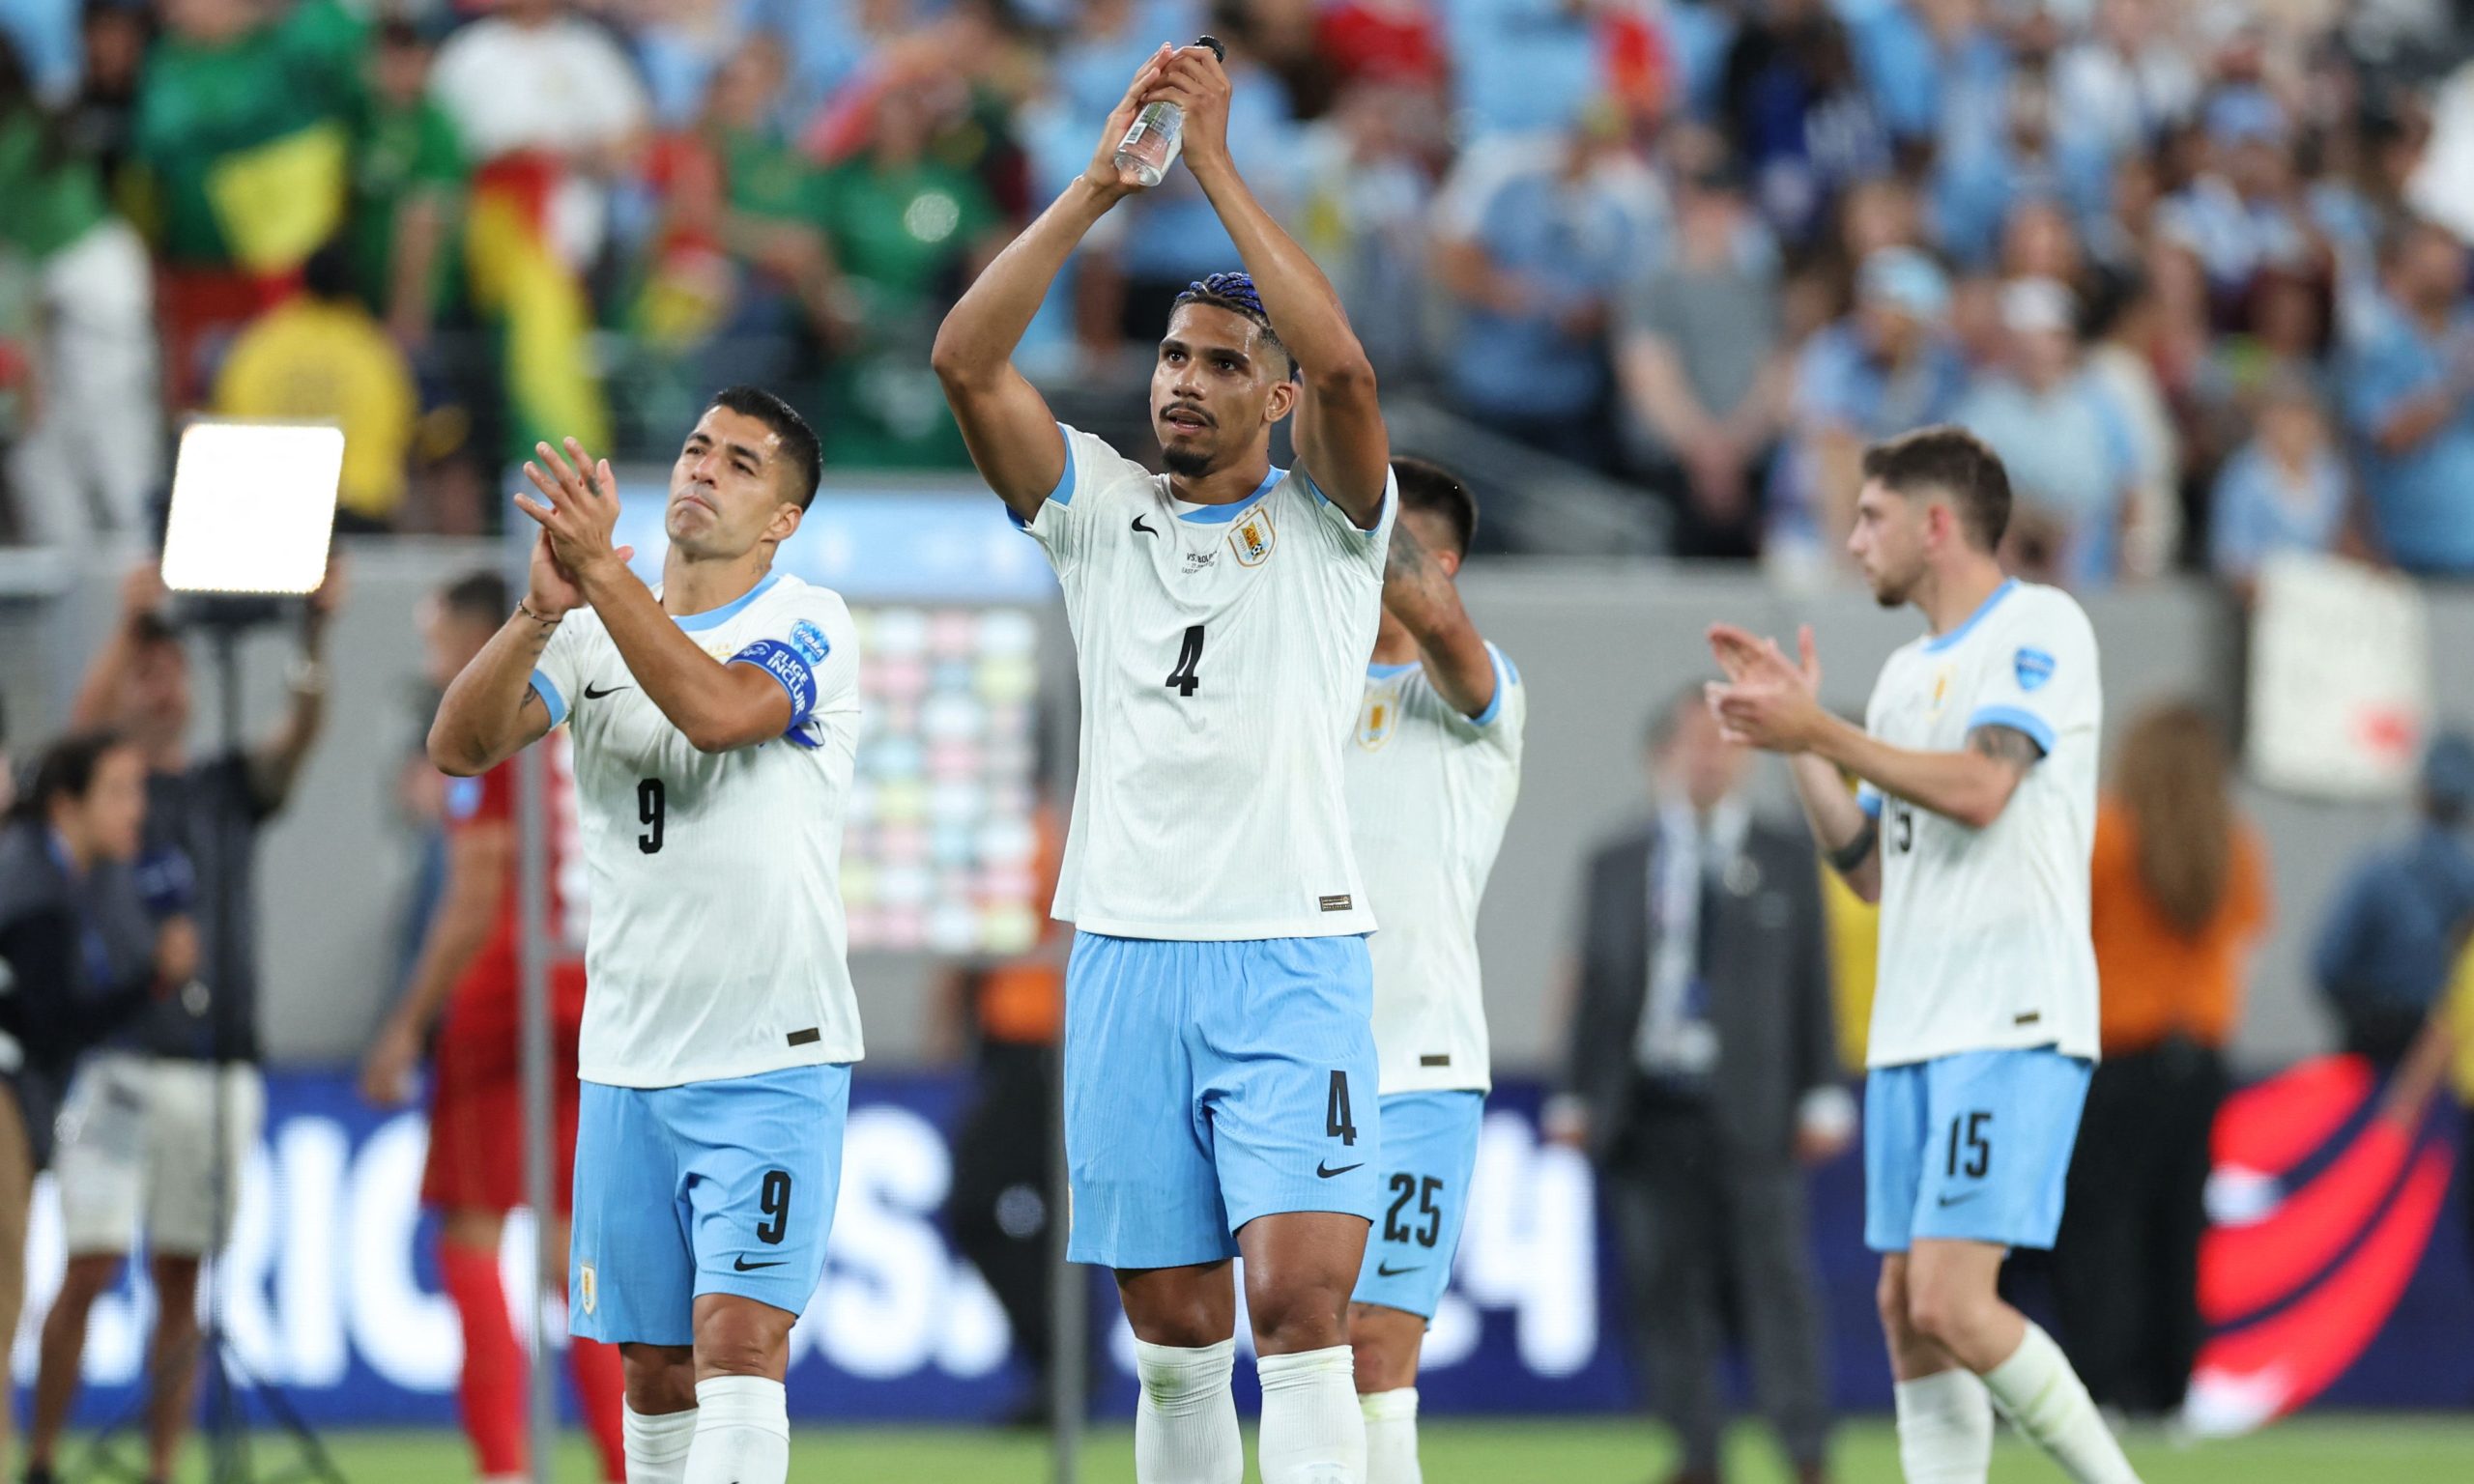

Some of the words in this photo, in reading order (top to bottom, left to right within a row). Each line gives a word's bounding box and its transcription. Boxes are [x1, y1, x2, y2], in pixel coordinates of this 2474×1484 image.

[766, 657, 806, 716] INCLUIR
[773, 649, 809, 687] ELIGE
[1165, 625, 1204, 697] 4
[637, 778, 665, 855] 9
[1326, 1070, 1357, 1146] 4
[1947, 1112, 1993, 1178] 15
[757, 1170, 791, 1244] 9
[1383, 1172, 1443, 1247] 25
